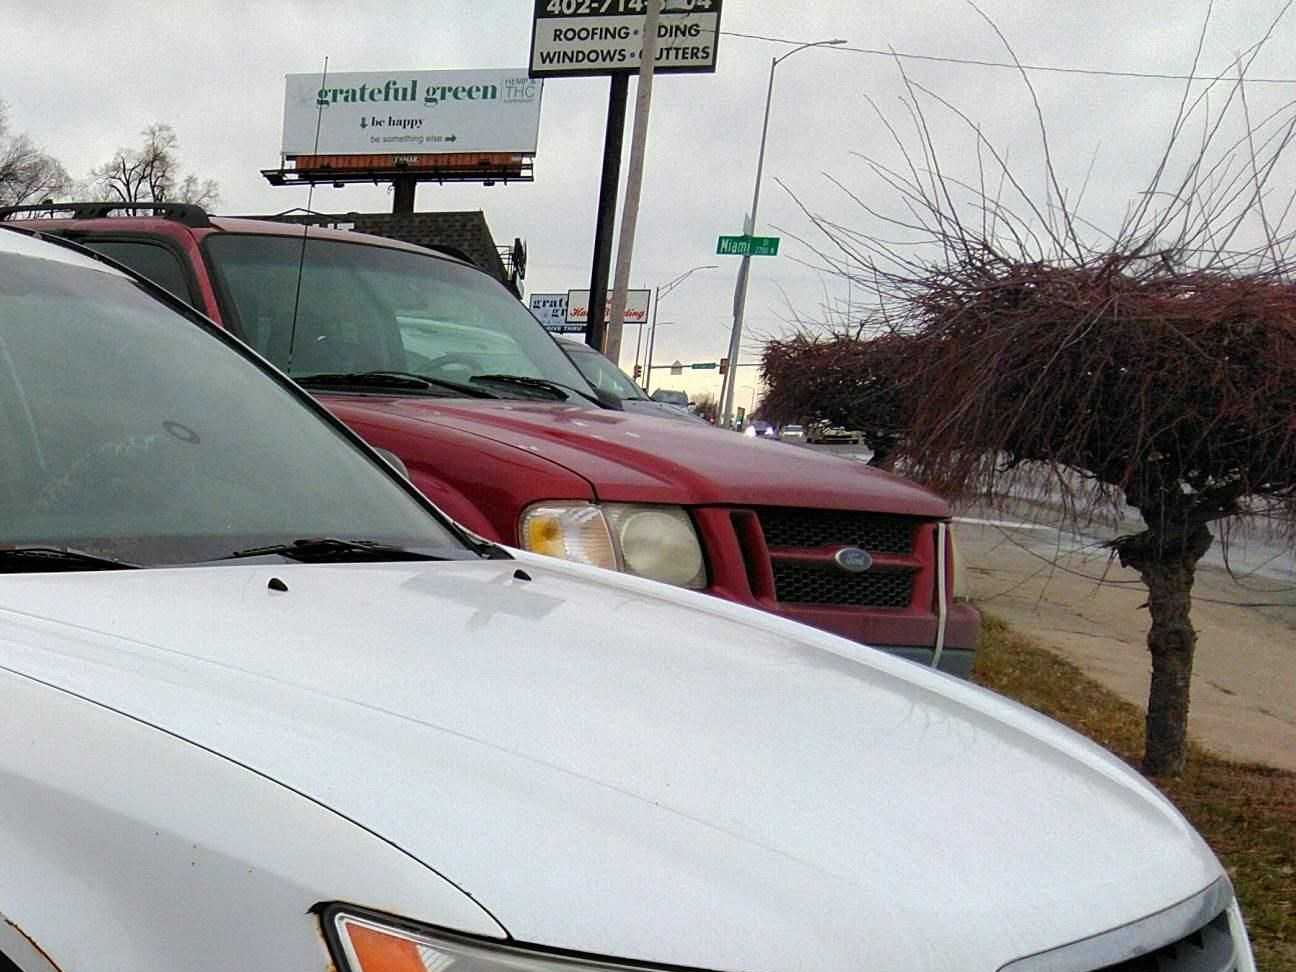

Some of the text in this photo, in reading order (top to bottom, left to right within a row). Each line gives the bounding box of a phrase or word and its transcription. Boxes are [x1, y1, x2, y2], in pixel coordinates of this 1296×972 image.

[552, 24, 701, 42] ROOFING DING
[539, 46, 711, 65] WINDOWS UTTERS
[316, 80, 497, 108] grateful green
[505, 87, 536, 98] THC
[371, 116, 425, 129] be happy
[370, 135, 381, 143] be
[383, 135, 424, 144] something
[719, 238, 751, 253] Miami
